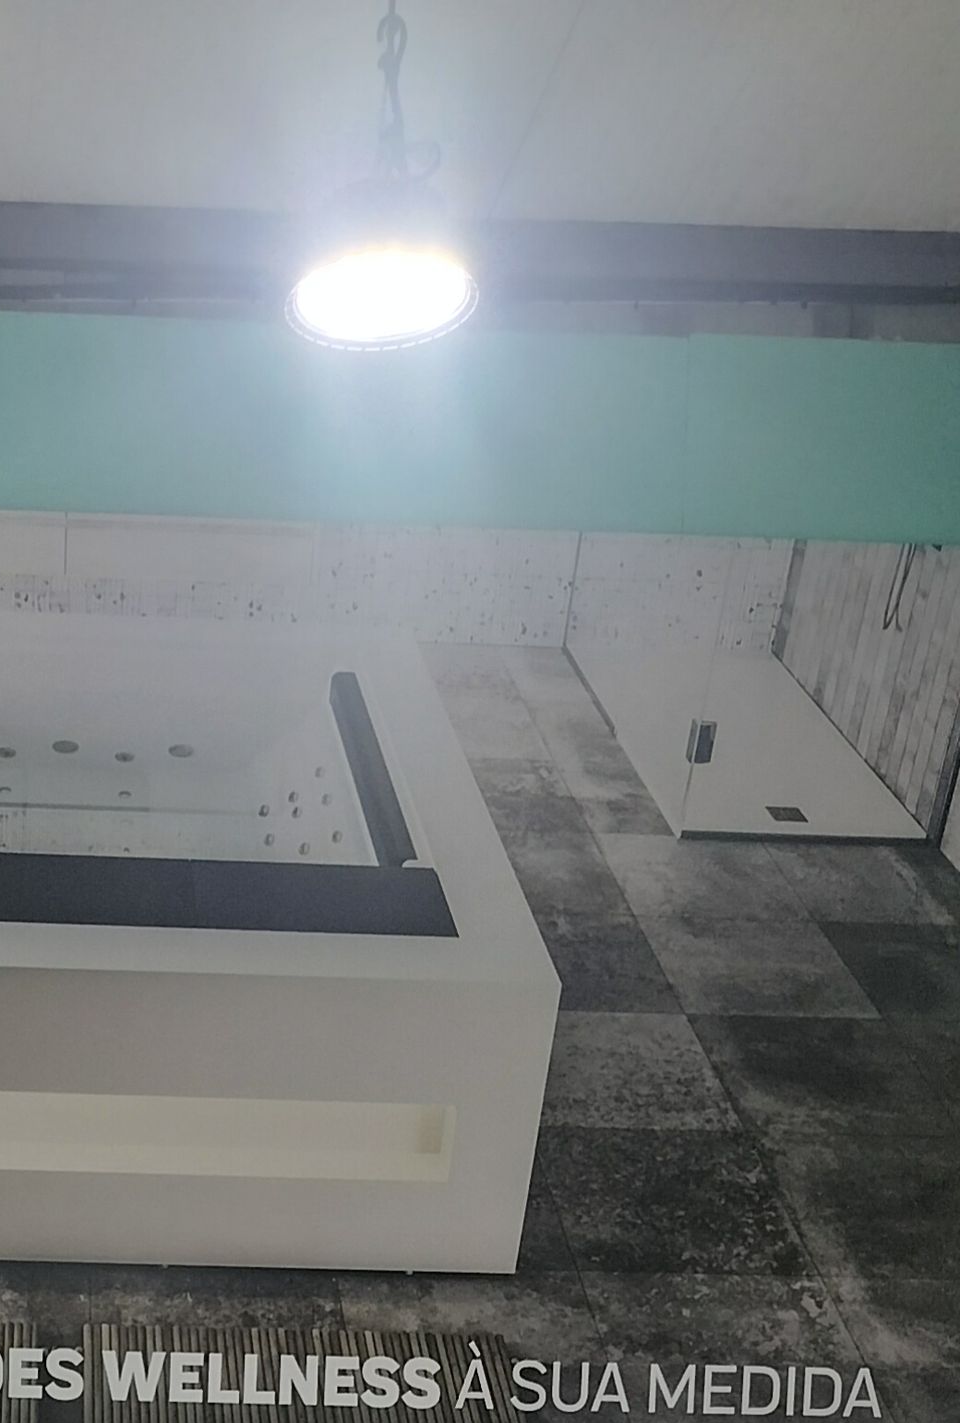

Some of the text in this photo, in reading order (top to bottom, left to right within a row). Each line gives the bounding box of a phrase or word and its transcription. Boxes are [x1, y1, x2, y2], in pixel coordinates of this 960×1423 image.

[102, 1349, 441, 1410] WELLNESS
[454, 1340, 494, 1410] À
[510, 1359, 630, 1413] SUA
[648, 1363, 882, 1418] MEDIDA
